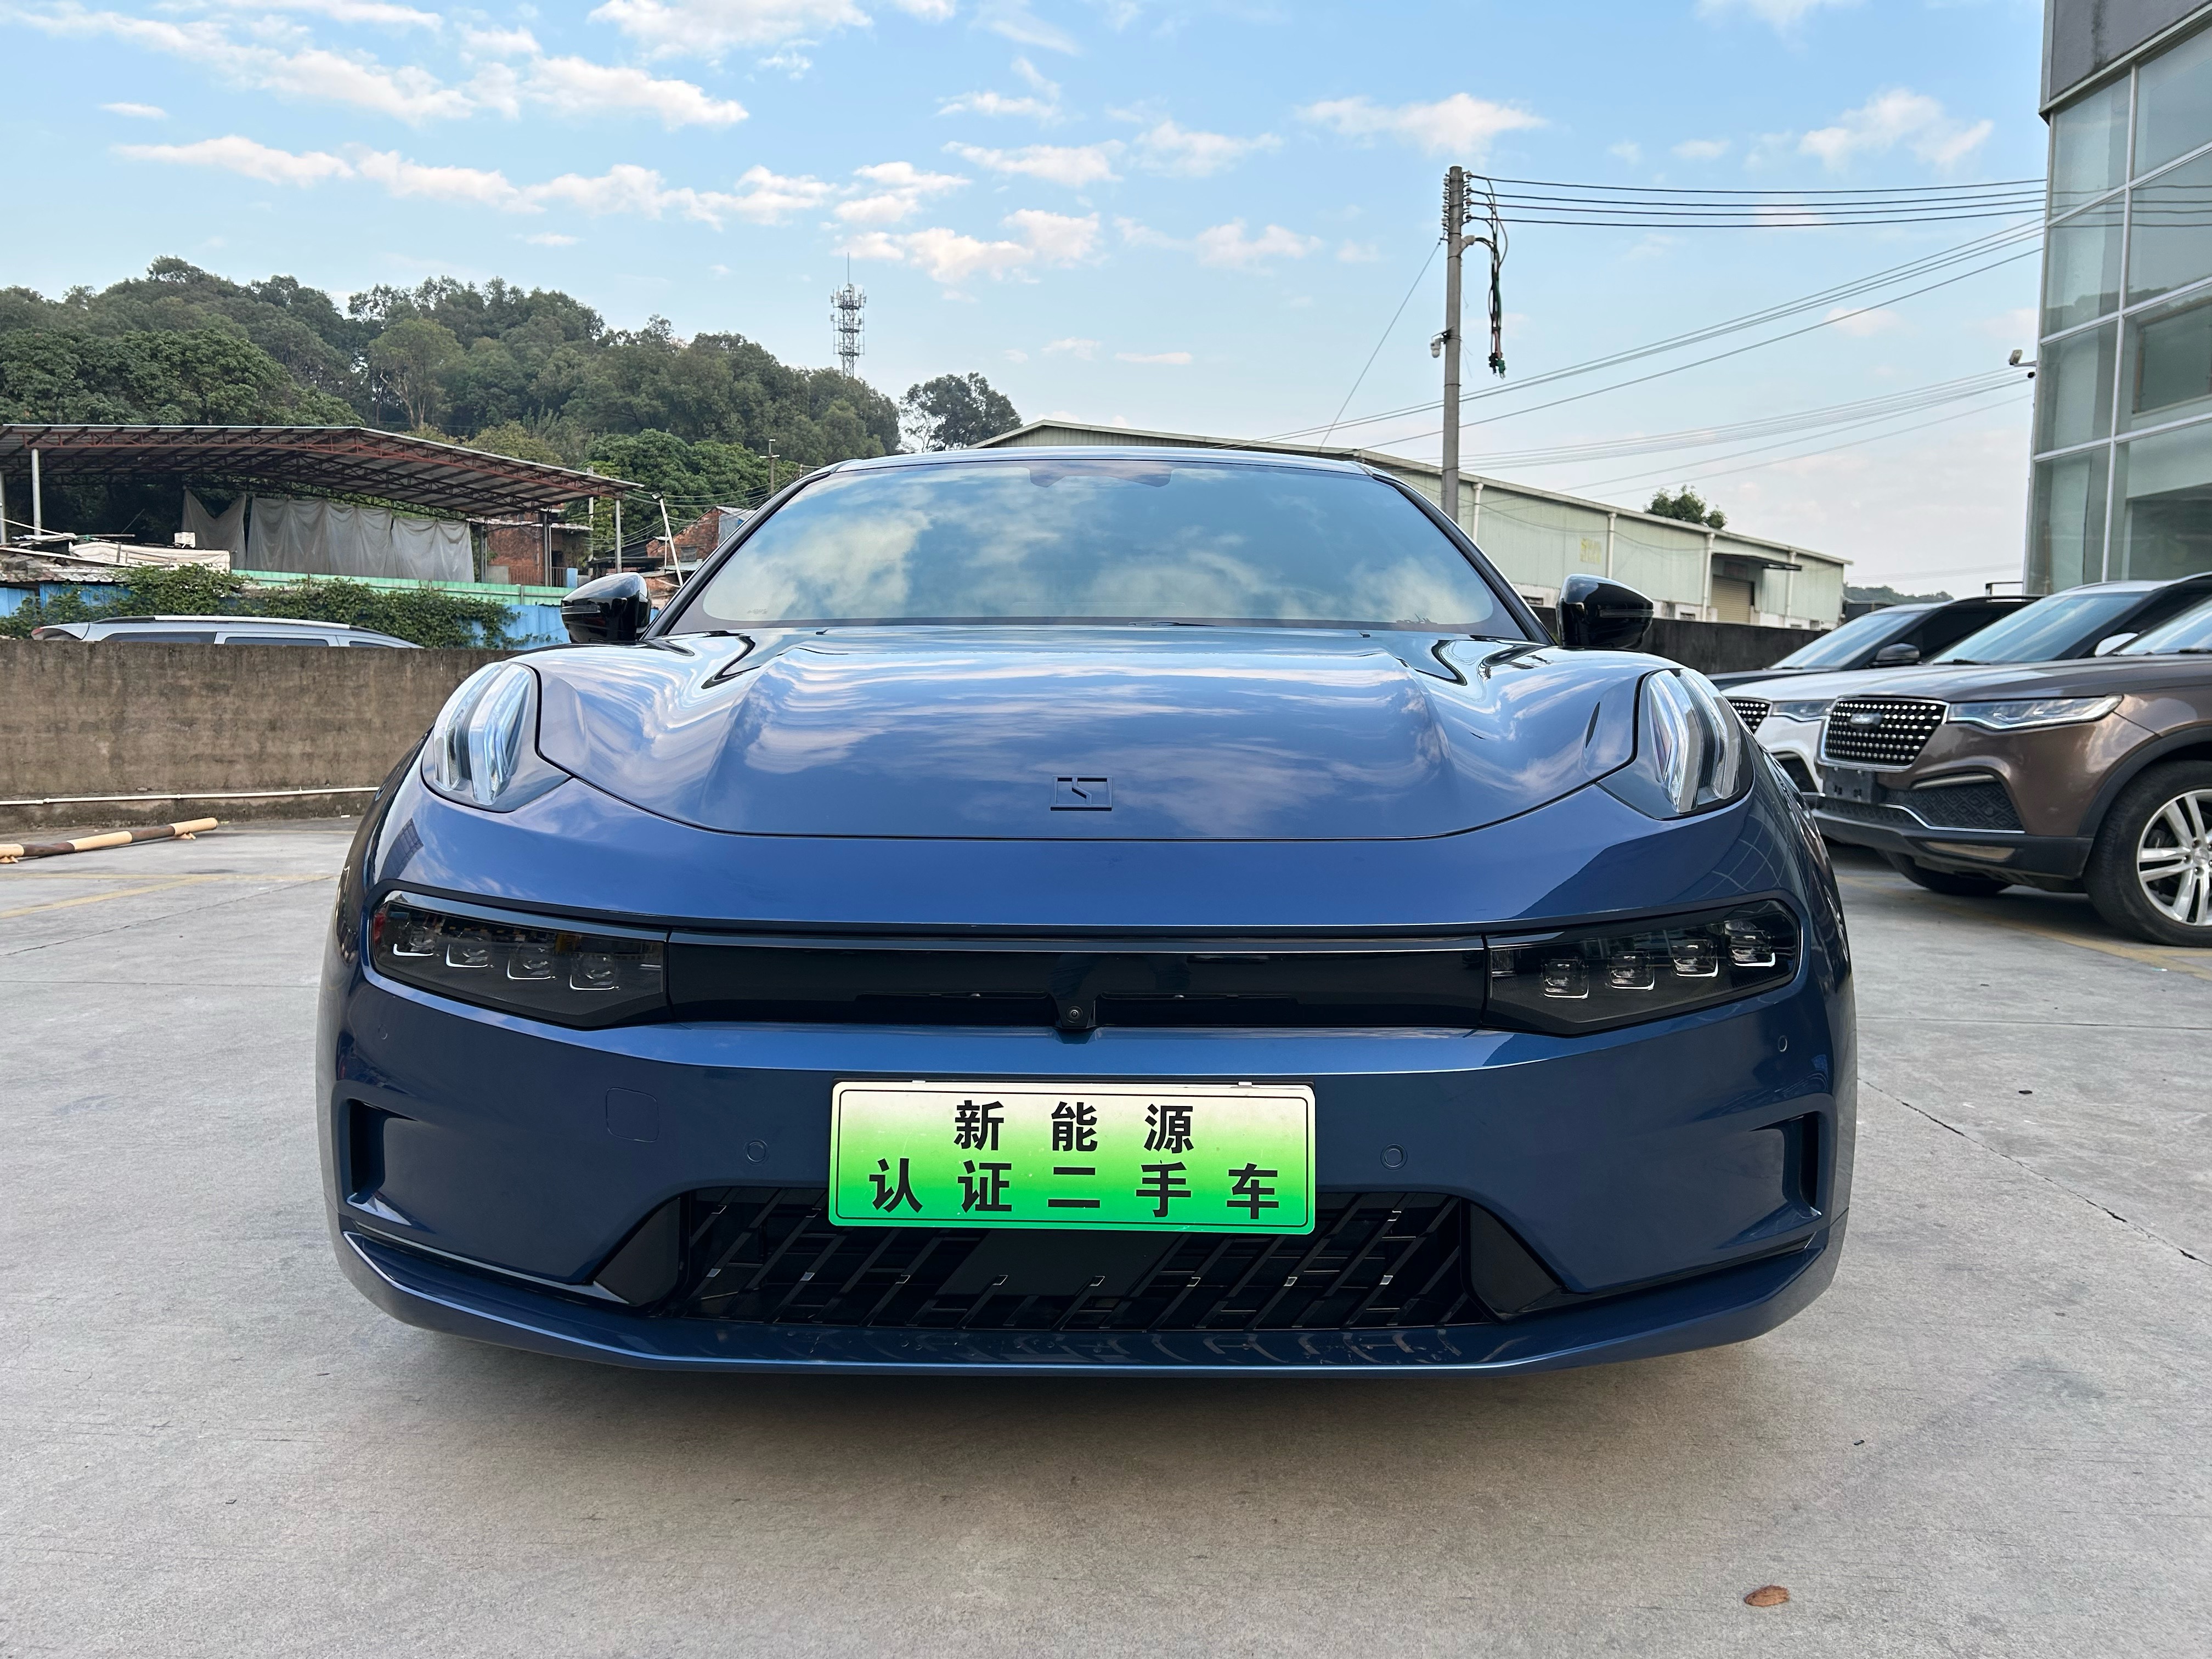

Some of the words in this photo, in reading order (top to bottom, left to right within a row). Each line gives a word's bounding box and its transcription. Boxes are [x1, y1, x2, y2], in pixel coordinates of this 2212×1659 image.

[953, 1099, 1195, 1154] 新能源
[869, 1157, 1280, 1220] 认证二手车
